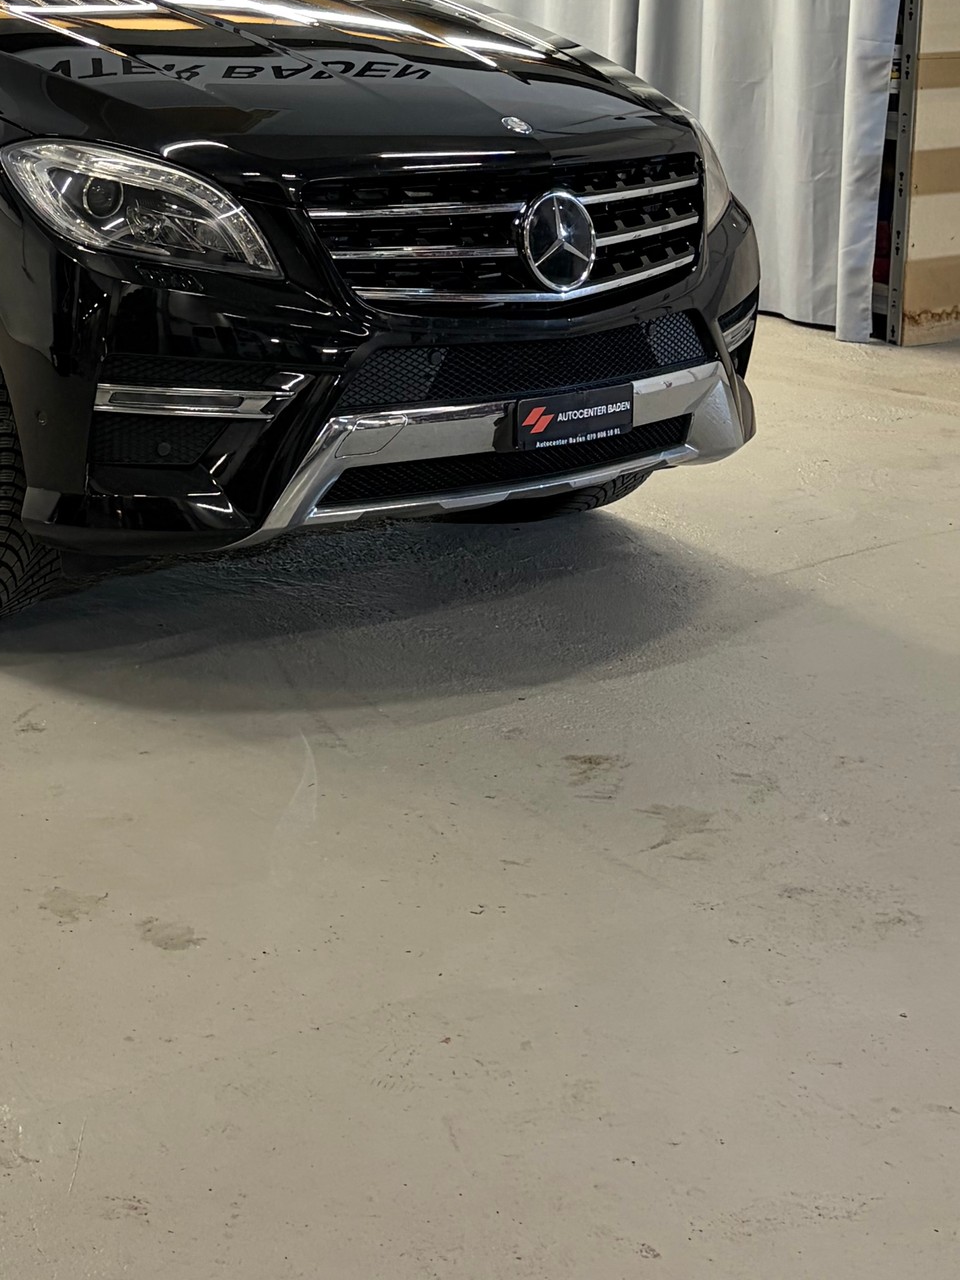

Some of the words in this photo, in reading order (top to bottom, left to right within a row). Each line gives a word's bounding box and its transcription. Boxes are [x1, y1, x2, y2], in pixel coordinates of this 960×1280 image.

[557, 405, 606, 422] AUTOCENTER
[608, 401, 630, 413] BADEN
[536, 439, 568, 448] Autocenter
[569, 435, 586, 444] Baden
